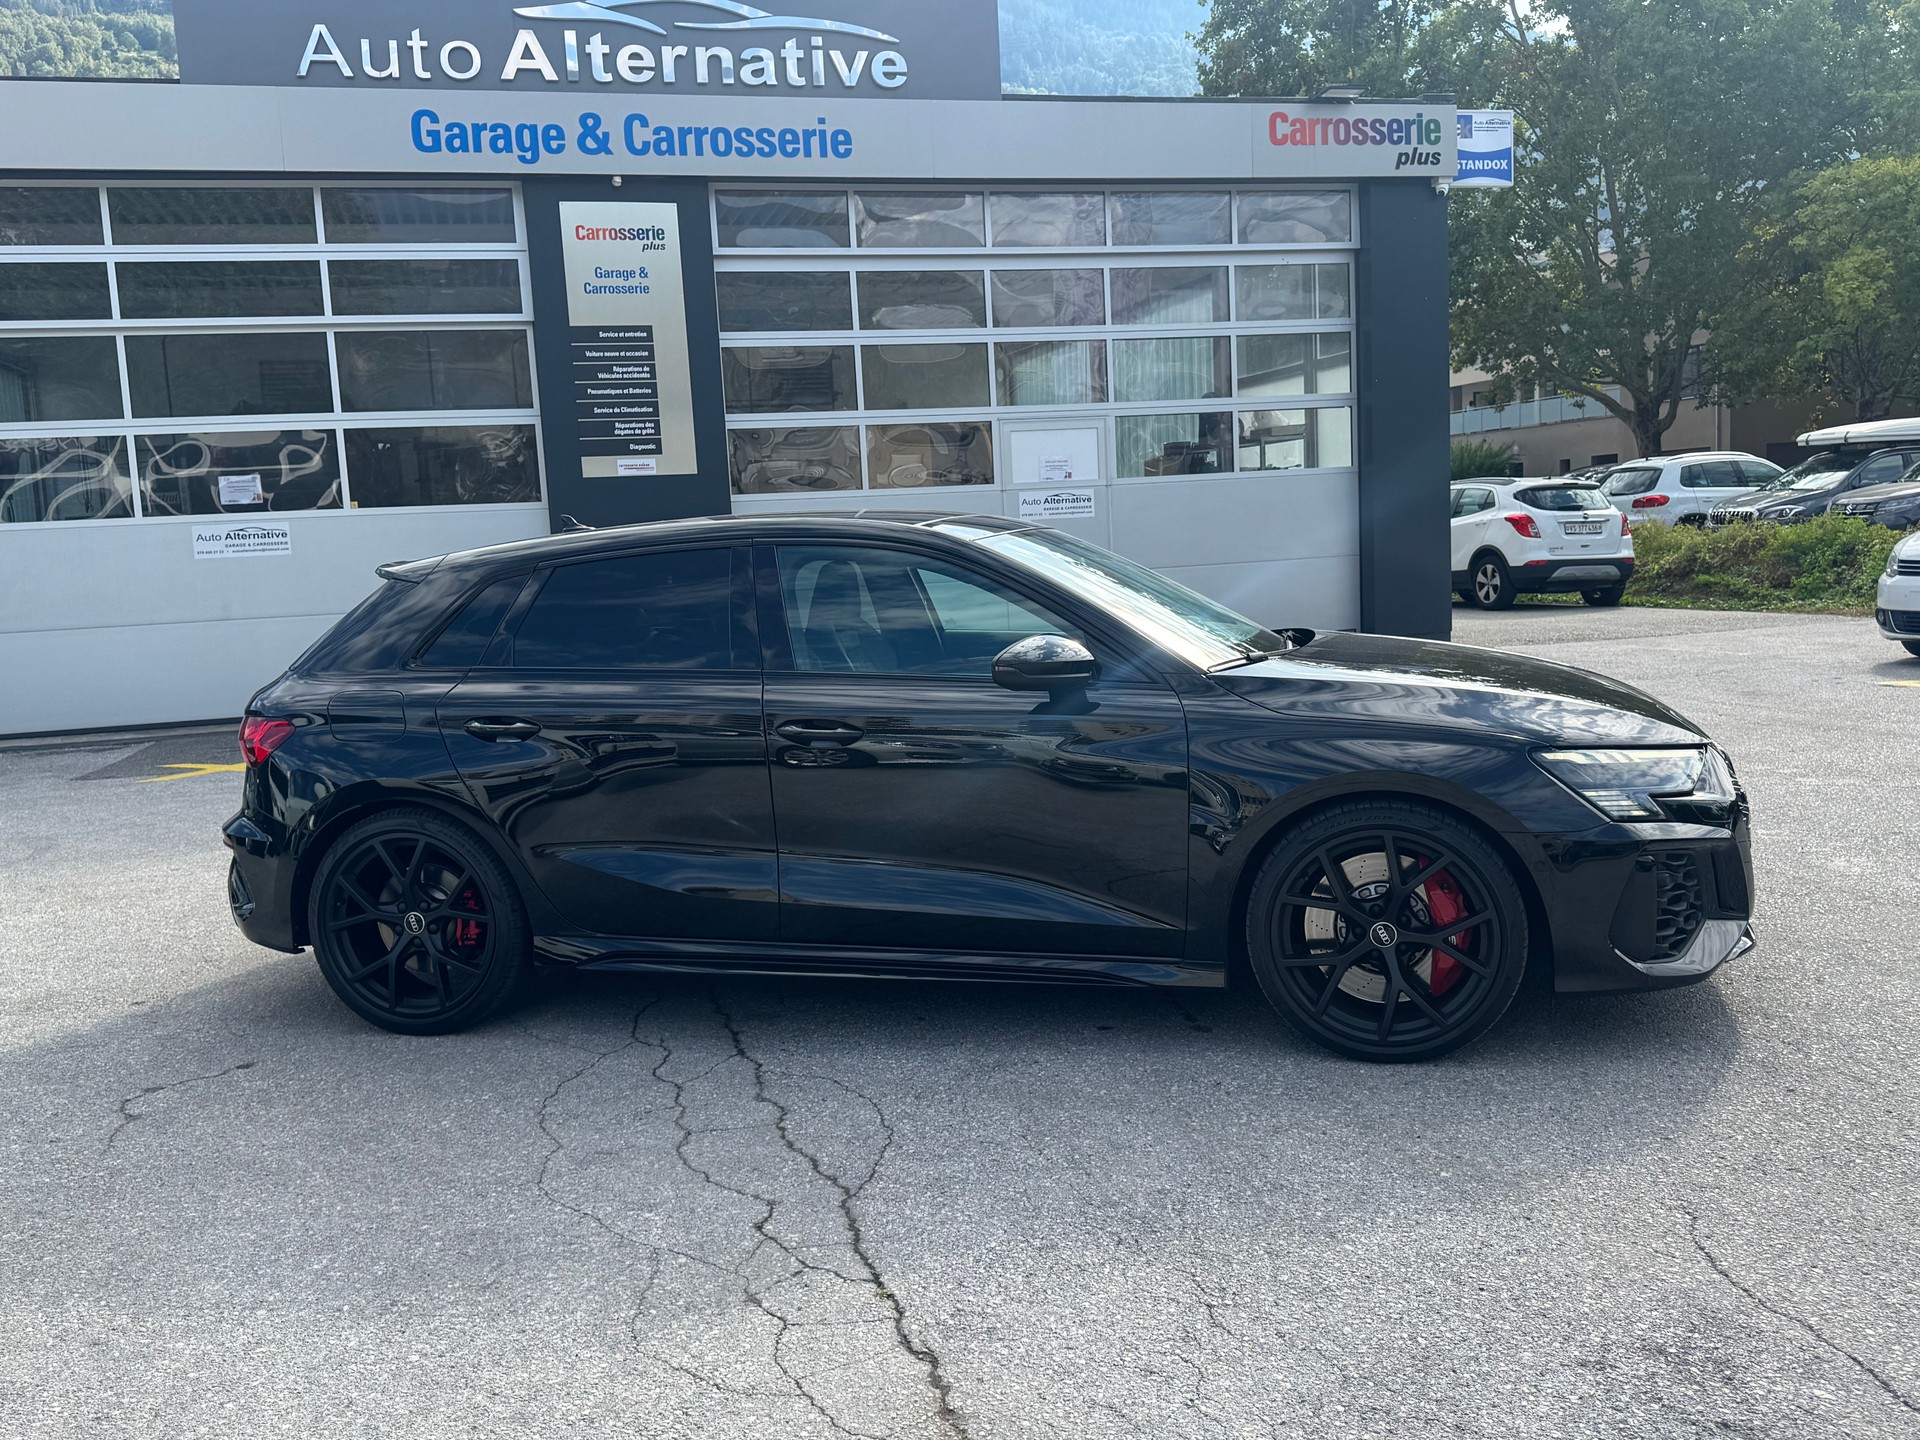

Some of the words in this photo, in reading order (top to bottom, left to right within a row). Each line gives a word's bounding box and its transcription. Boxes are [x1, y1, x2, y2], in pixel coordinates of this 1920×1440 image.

[295, 23, 482, 81] Auto
[500, 28, 909, 89] Alternative
[410, 108, 566, 164] Garage
[576, 112, 614, 156] &
[623, 112, 854, 159] Carrosserie
[1268, 111, 1442, 147] Carrosserie
[1395, 146, 1442, 170] plus
[575, 224, 666, 242] Carrosserie
[642, 241, 666, 253] plus
[594, 266, 637, 282] Garage
[638, 266, 649, 279] &
[584, 282, 650, 295] Carrosserie
[1021, 498, 1042, 506] Auto
[1043, 496, 1092, 505] Alternative
[195, 533, 222, 542] Auto
[224, 530, 288, 541] Alternative
